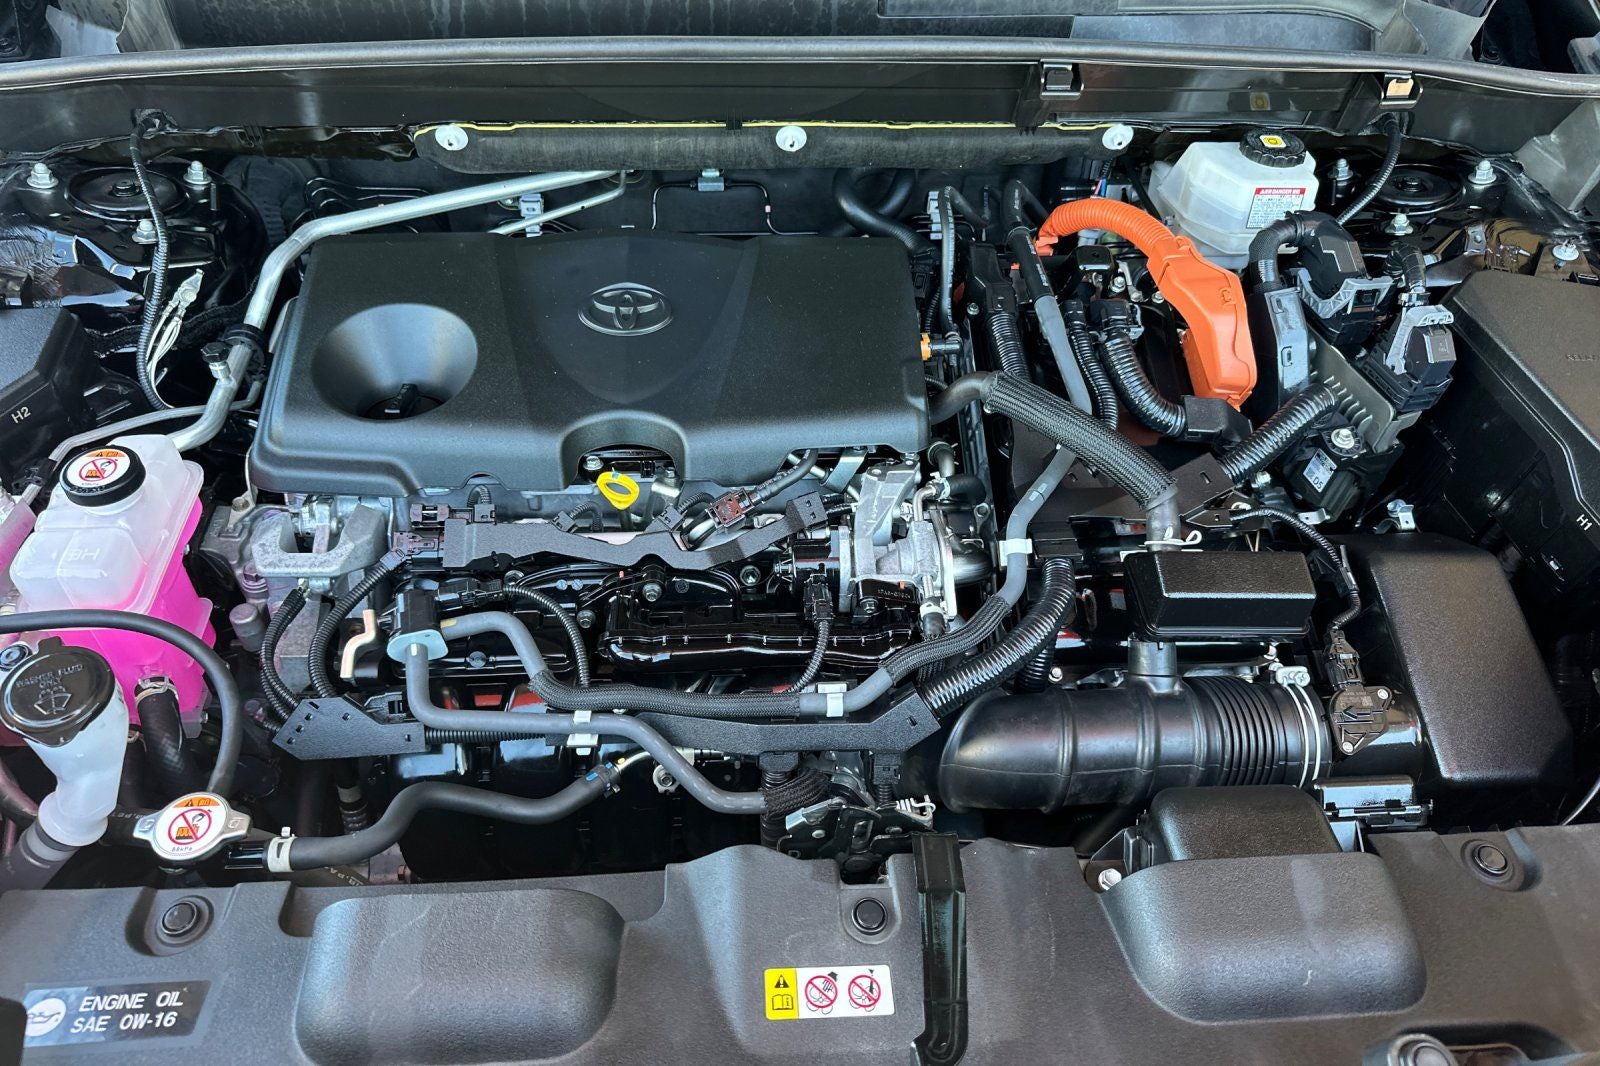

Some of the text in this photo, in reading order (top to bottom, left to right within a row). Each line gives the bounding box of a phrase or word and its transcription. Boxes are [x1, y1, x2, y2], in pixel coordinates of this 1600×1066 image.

[11, 406, 31, 424] H2
[1576, 513, 1593, 531] H1
[15, 663, 83, 688] WASHER FLUID
[39, 677, 61, 689] ONLY
[78, 991, 184, 1012] ENGINE OIL
[69, 1015, 111, 1034] SAE
